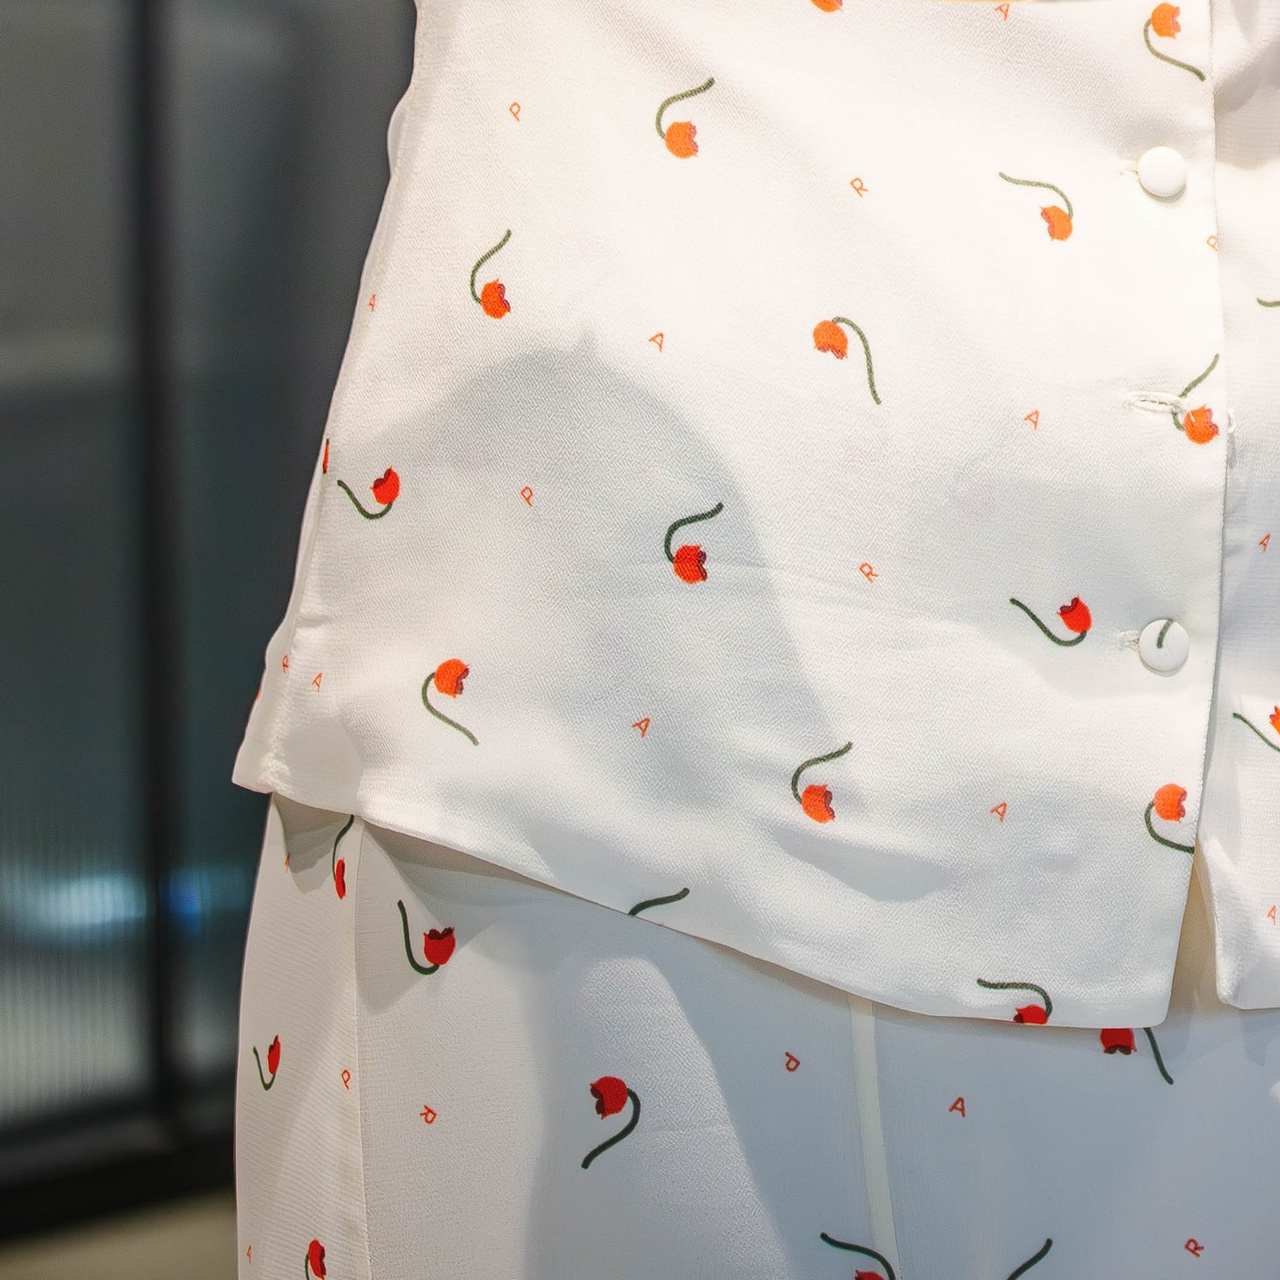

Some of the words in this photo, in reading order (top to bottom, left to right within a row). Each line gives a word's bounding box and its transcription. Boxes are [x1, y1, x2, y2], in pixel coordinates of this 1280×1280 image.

[994, 3, 1011, 21] A
[509, 101, 521, 123] P
[849, 177, 870, 198] R
[648, 331, 665, 353] A
[1023, 409, 1040, 430] A
[519, 485, 534, 508] P
[1259, 532, 1272, 552] A
[858, 562, 879, 584] R
[311, 672, 323, 693] A
[632, 716, 651, 738] A
[990, 801, 1008, 823] A
[1266, 904, 1277, 926] A
[785, 1052, 801, 1072] P
[340, 1069, 352, 1092] P
[420, 1104, 438, 1126] R
[949, 1096, 966, 1117] A
[1185, 1238, 1204, 1258] R
